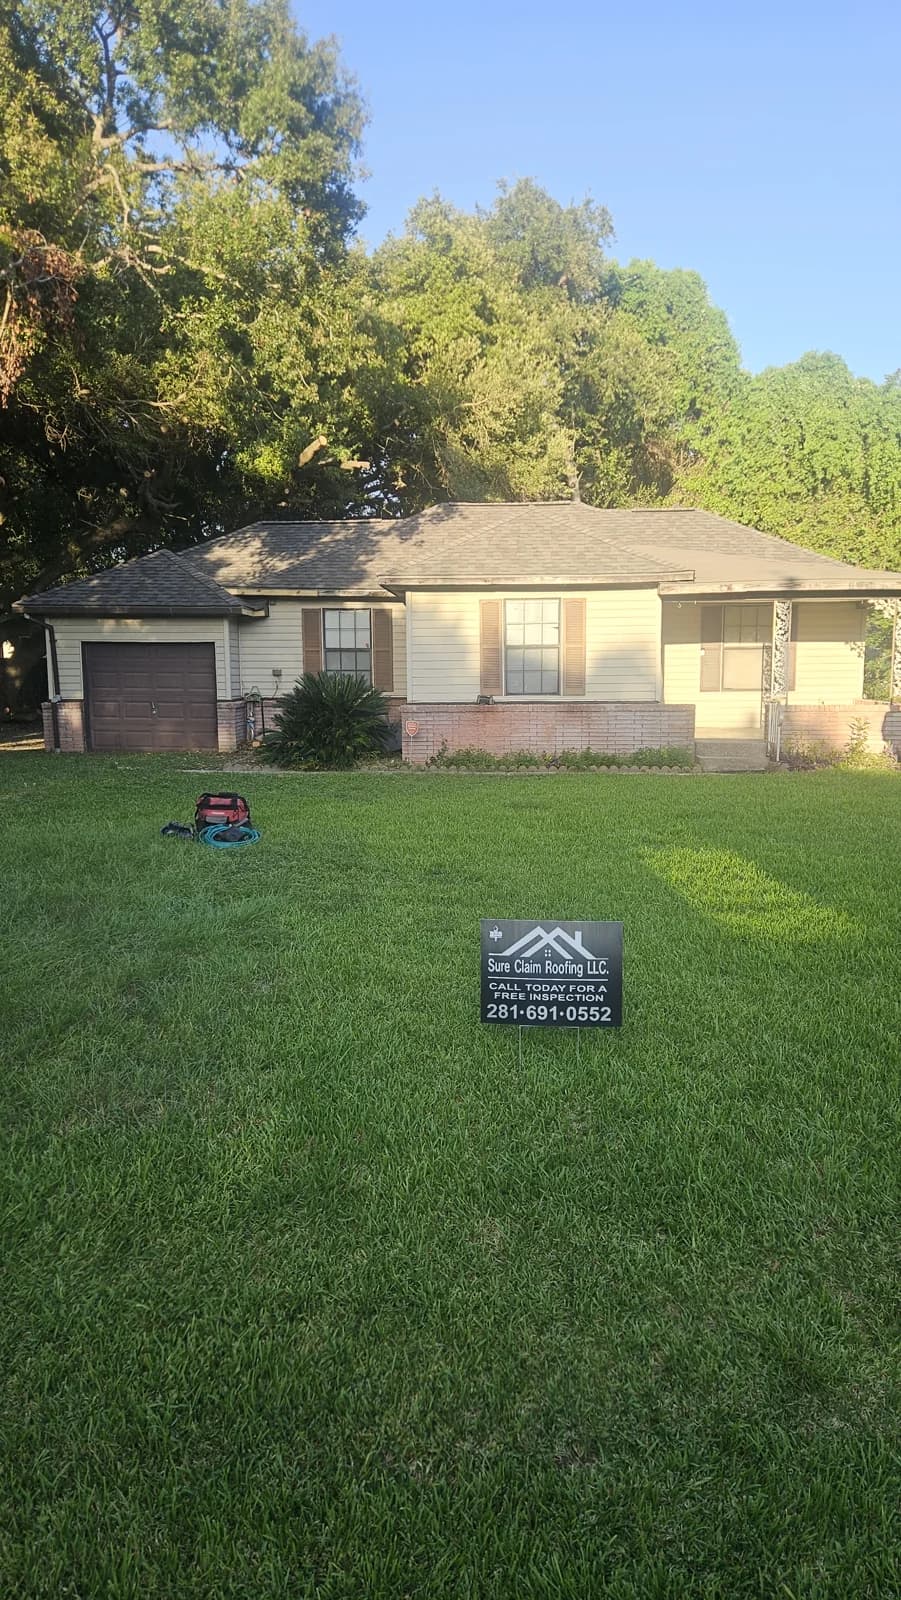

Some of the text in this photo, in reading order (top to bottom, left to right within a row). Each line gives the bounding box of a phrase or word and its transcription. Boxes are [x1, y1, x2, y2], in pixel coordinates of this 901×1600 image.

[488, 958, 609, 977] Sure Claim Roofing LLC.
[489, 982, 607, 993] CALL TODAY FOR A
[494, 992, 604, 1001] FREE INSPECTION
